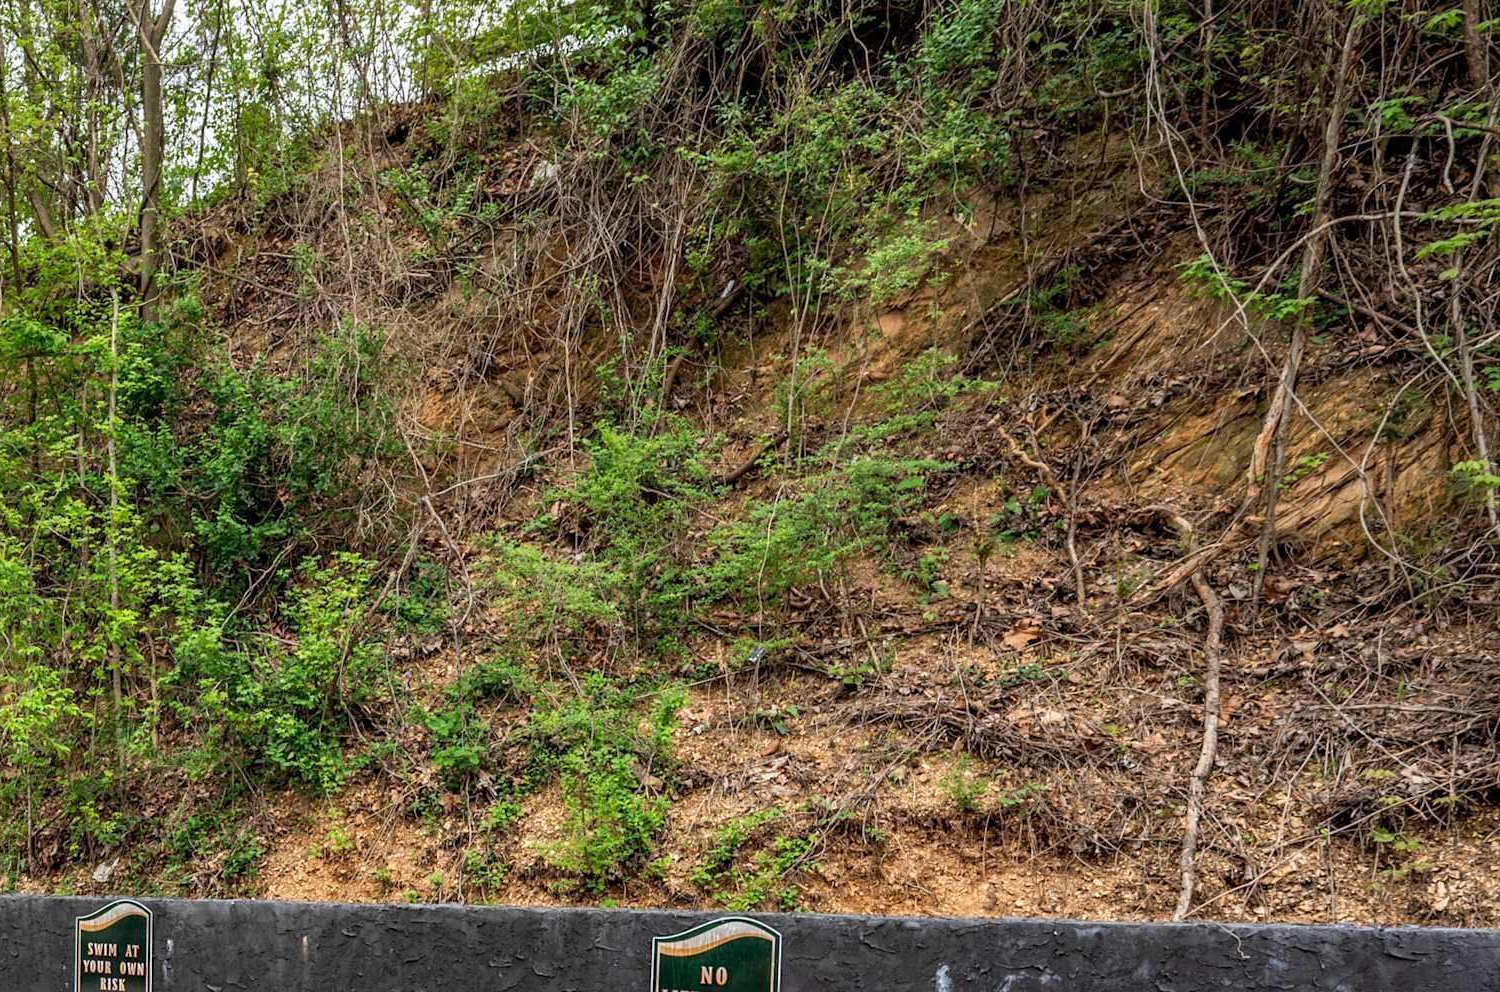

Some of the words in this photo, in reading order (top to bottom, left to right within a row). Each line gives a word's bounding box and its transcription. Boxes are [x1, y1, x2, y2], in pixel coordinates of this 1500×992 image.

[87, 942, 117, 957] SWIM
[125, 945, 140, 958] AT
[83, 959, 111, 974] YOUR
[119, 962, 145, 977] OWN
[700, 966, 728, 986] NO
[100, 977, 126, 992] RISK
